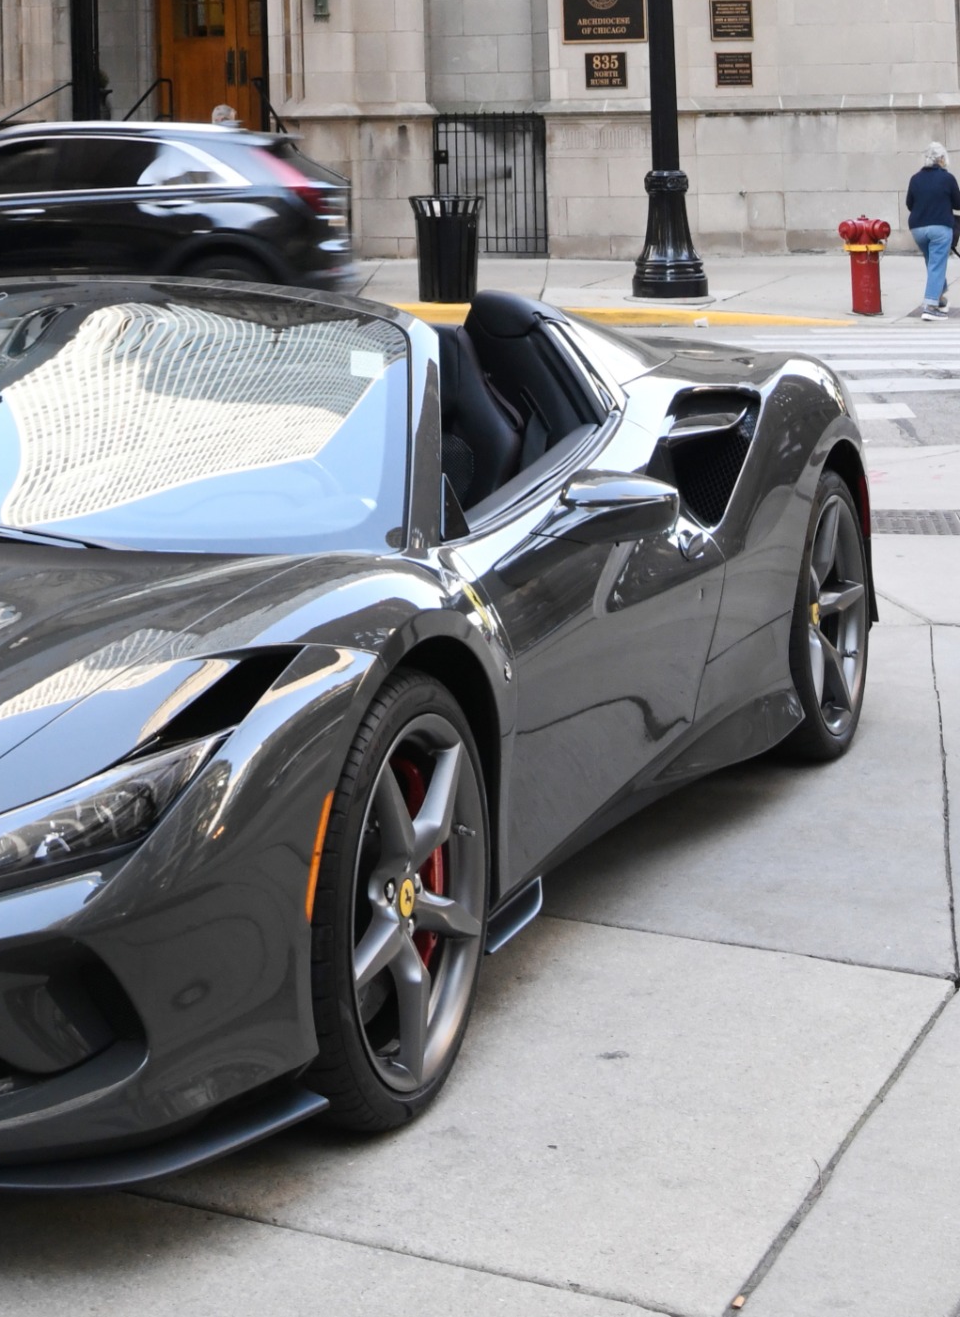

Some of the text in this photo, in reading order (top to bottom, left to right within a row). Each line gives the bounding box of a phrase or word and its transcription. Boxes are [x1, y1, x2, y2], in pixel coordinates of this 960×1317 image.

[577, 16, 630, 26] ARCHDIOCESE
[581, 26, 627, 35] OF CHICAGO
[592, 54, 619, 70] 835
[594, 70, 619, 78] NORTH
